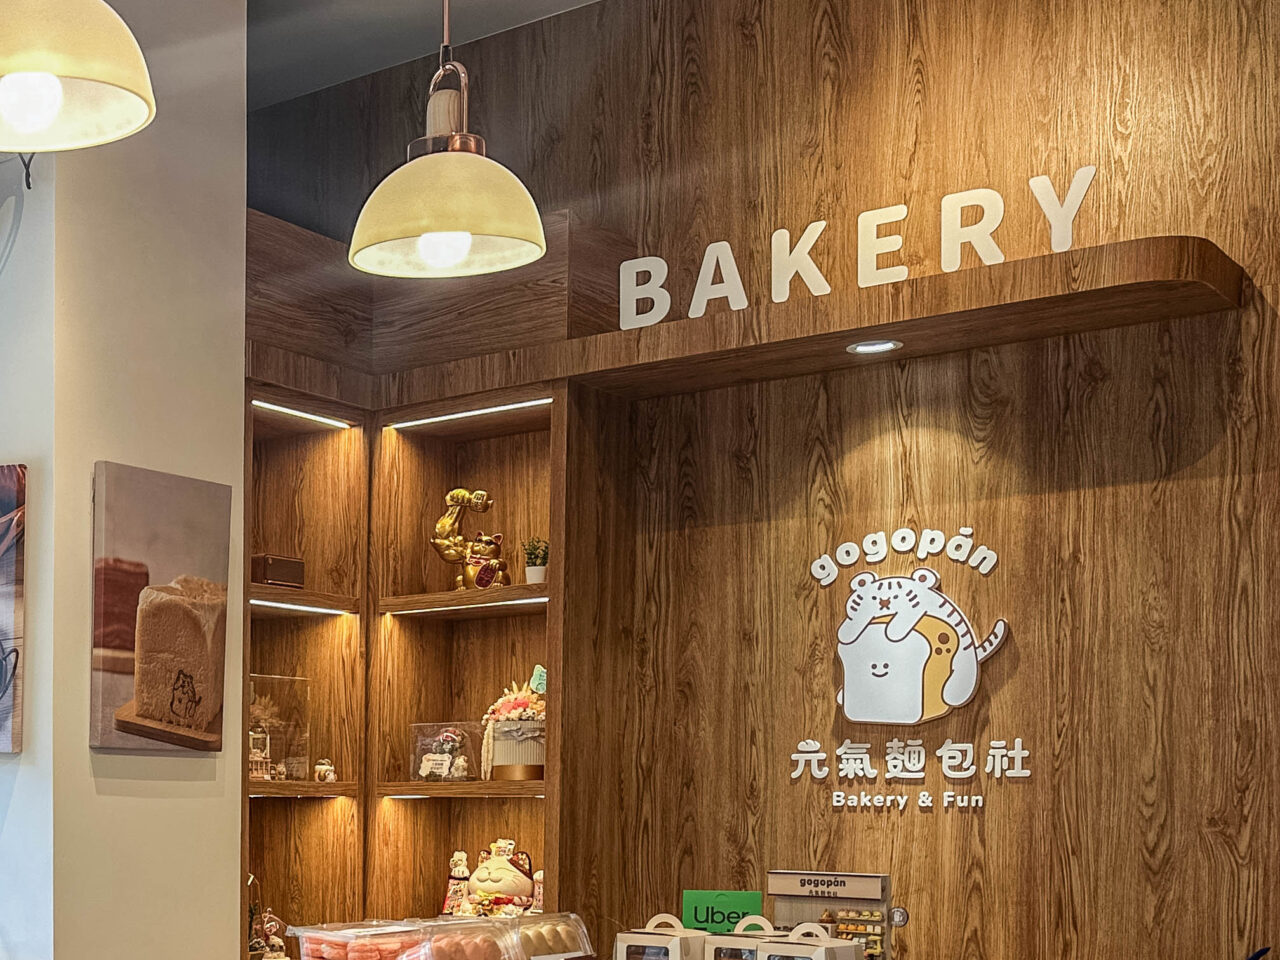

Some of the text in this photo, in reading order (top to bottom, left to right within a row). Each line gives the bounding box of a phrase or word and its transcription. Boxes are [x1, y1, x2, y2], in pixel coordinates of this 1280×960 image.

[618, 164, 1097, 331] BAKERY
[810, 526, 998, 587] gogopán
[790, 737, 1032, 780] 元氣麵包社
[831, 790, 985, 810] Bakery & Fun
[799, 877, 847, 889] gogopán
[693, 905, 750, 925] Uber
